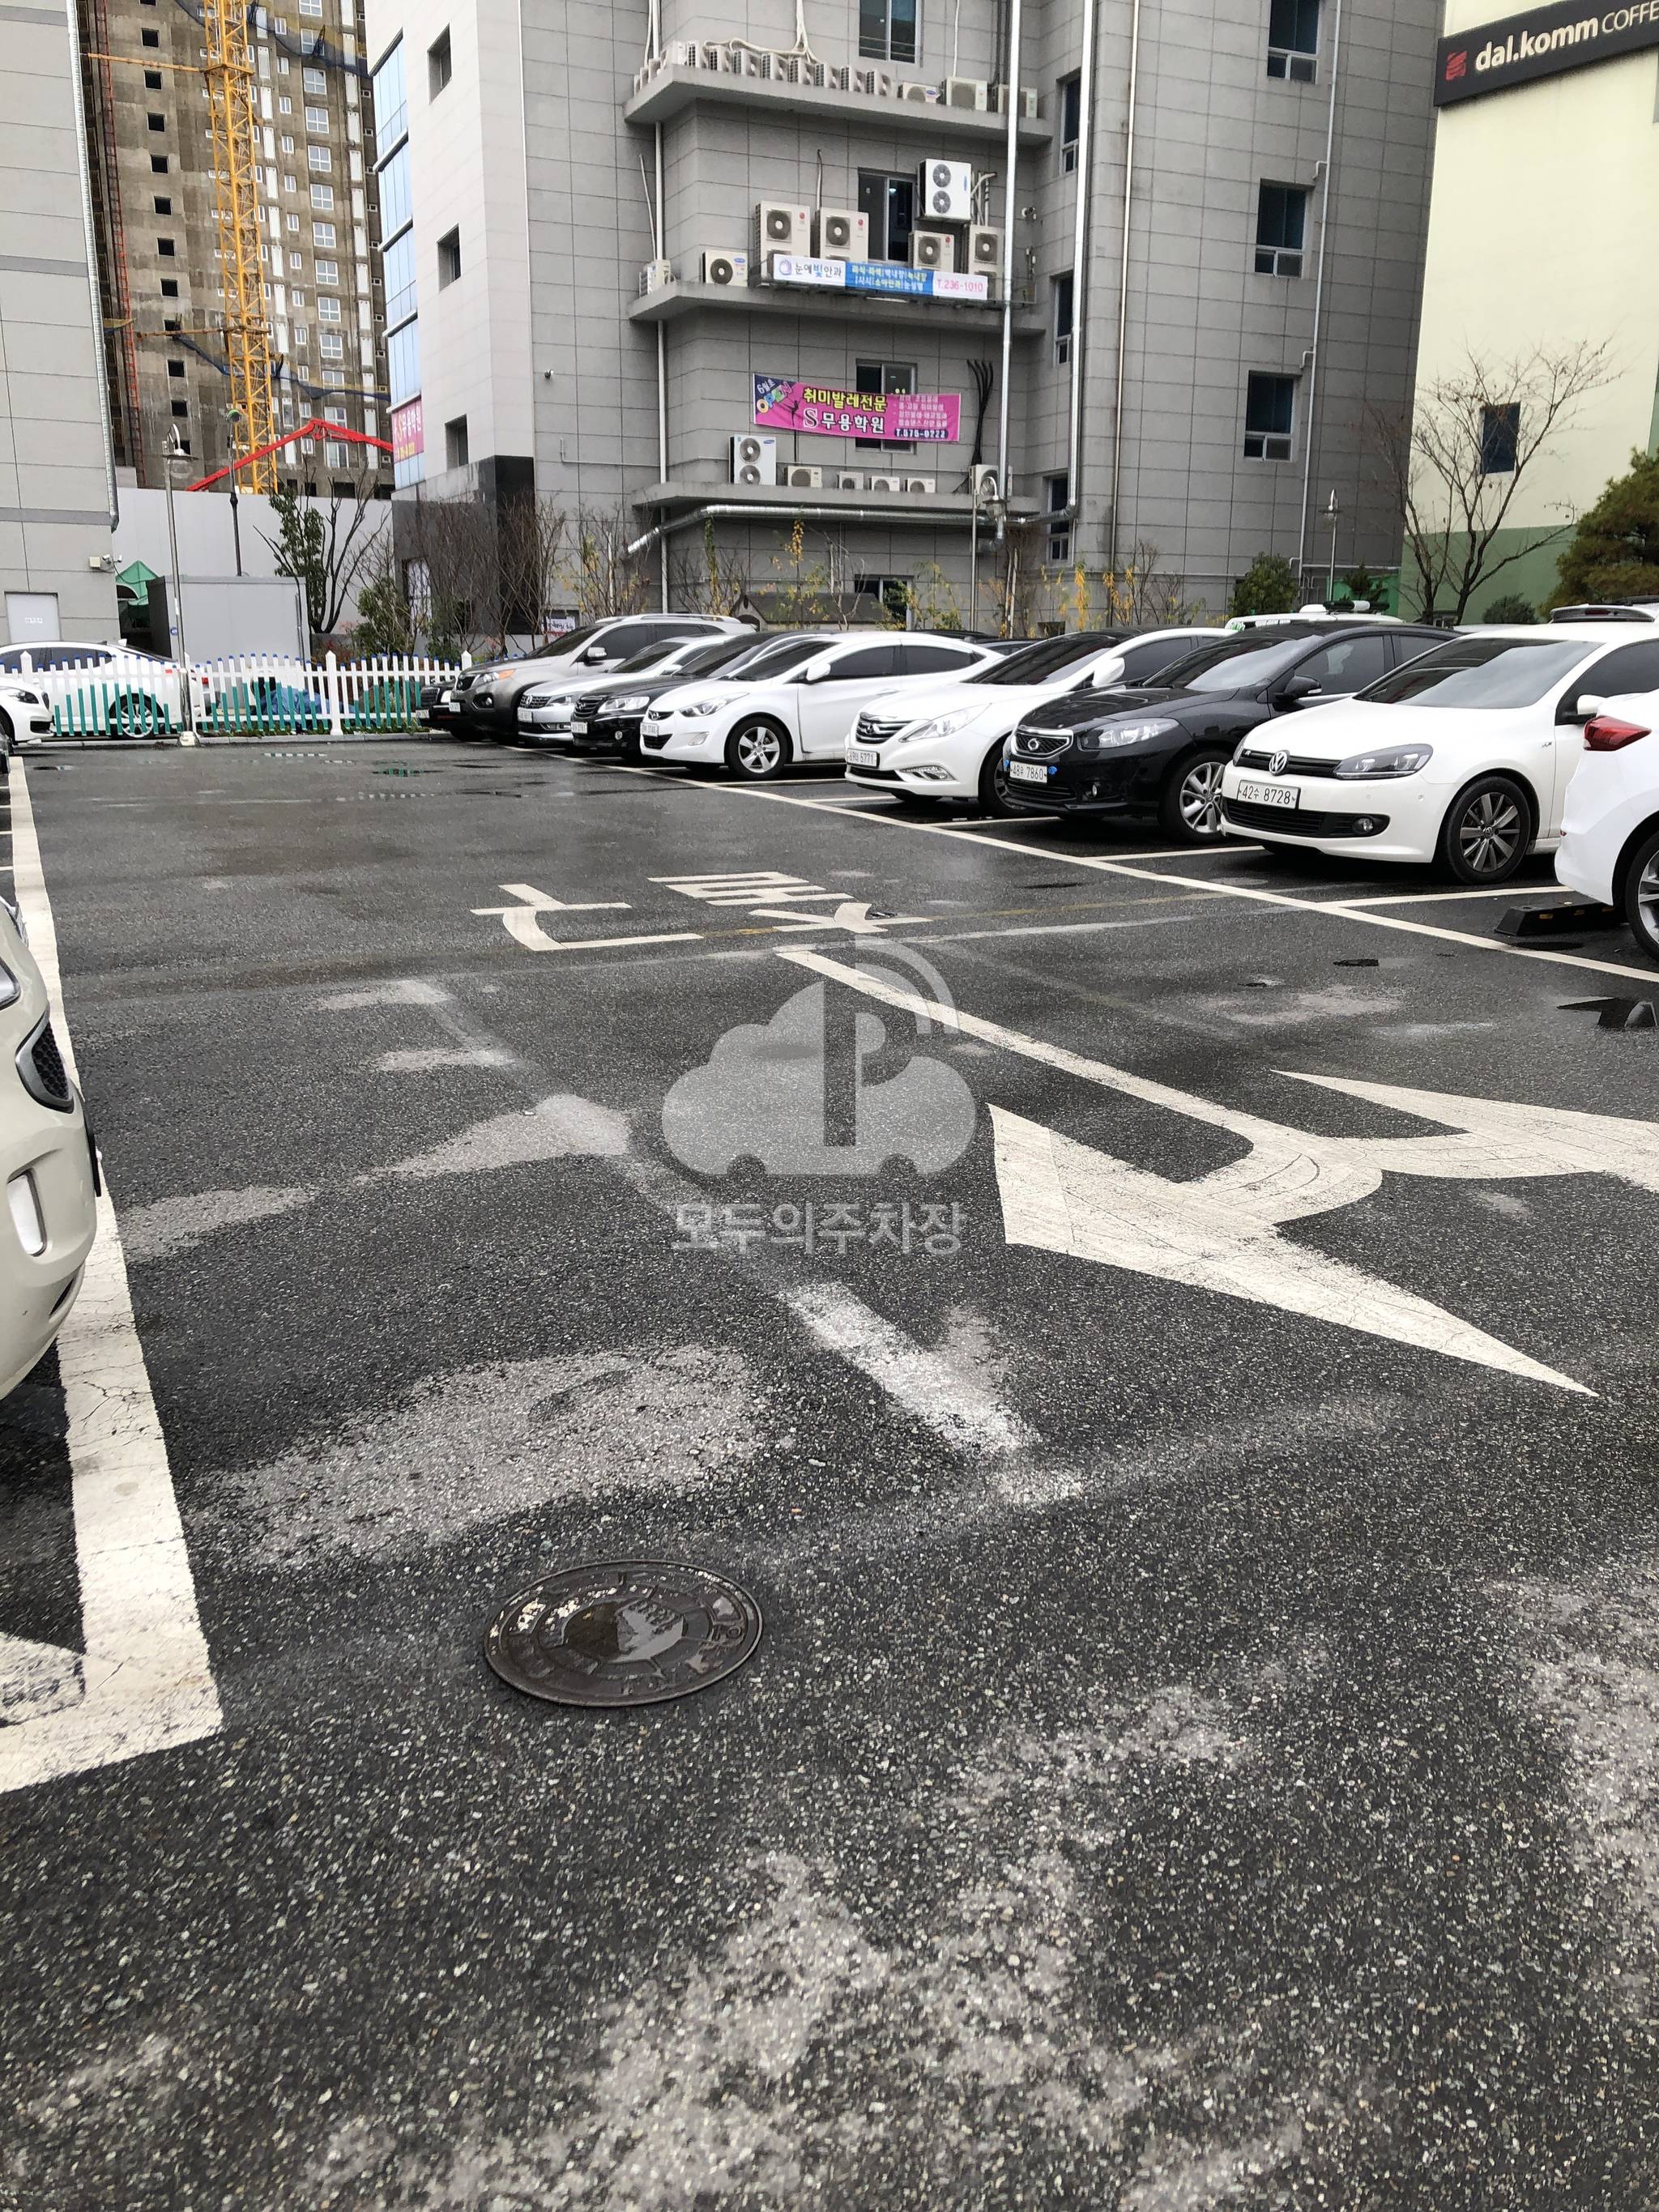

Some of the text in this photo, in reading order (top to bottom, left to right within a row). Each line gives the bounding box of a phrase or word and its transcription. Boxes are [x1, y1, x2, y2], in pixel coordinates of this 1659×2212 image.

[1474, 17, 1599, 71] dal.komm
[795, 262, 842, 278] 눈에빛안과
[936, 279, 983, 292] T.236-1010
[756, 381, 792, 414] OPEN
[804, 387, 888, 412] 취미발레전문
[821, 411, 885, 434] 무용학원
[1026, 766, 1043, 780] 7860
[1263, 787, 1291, 804] 8728
